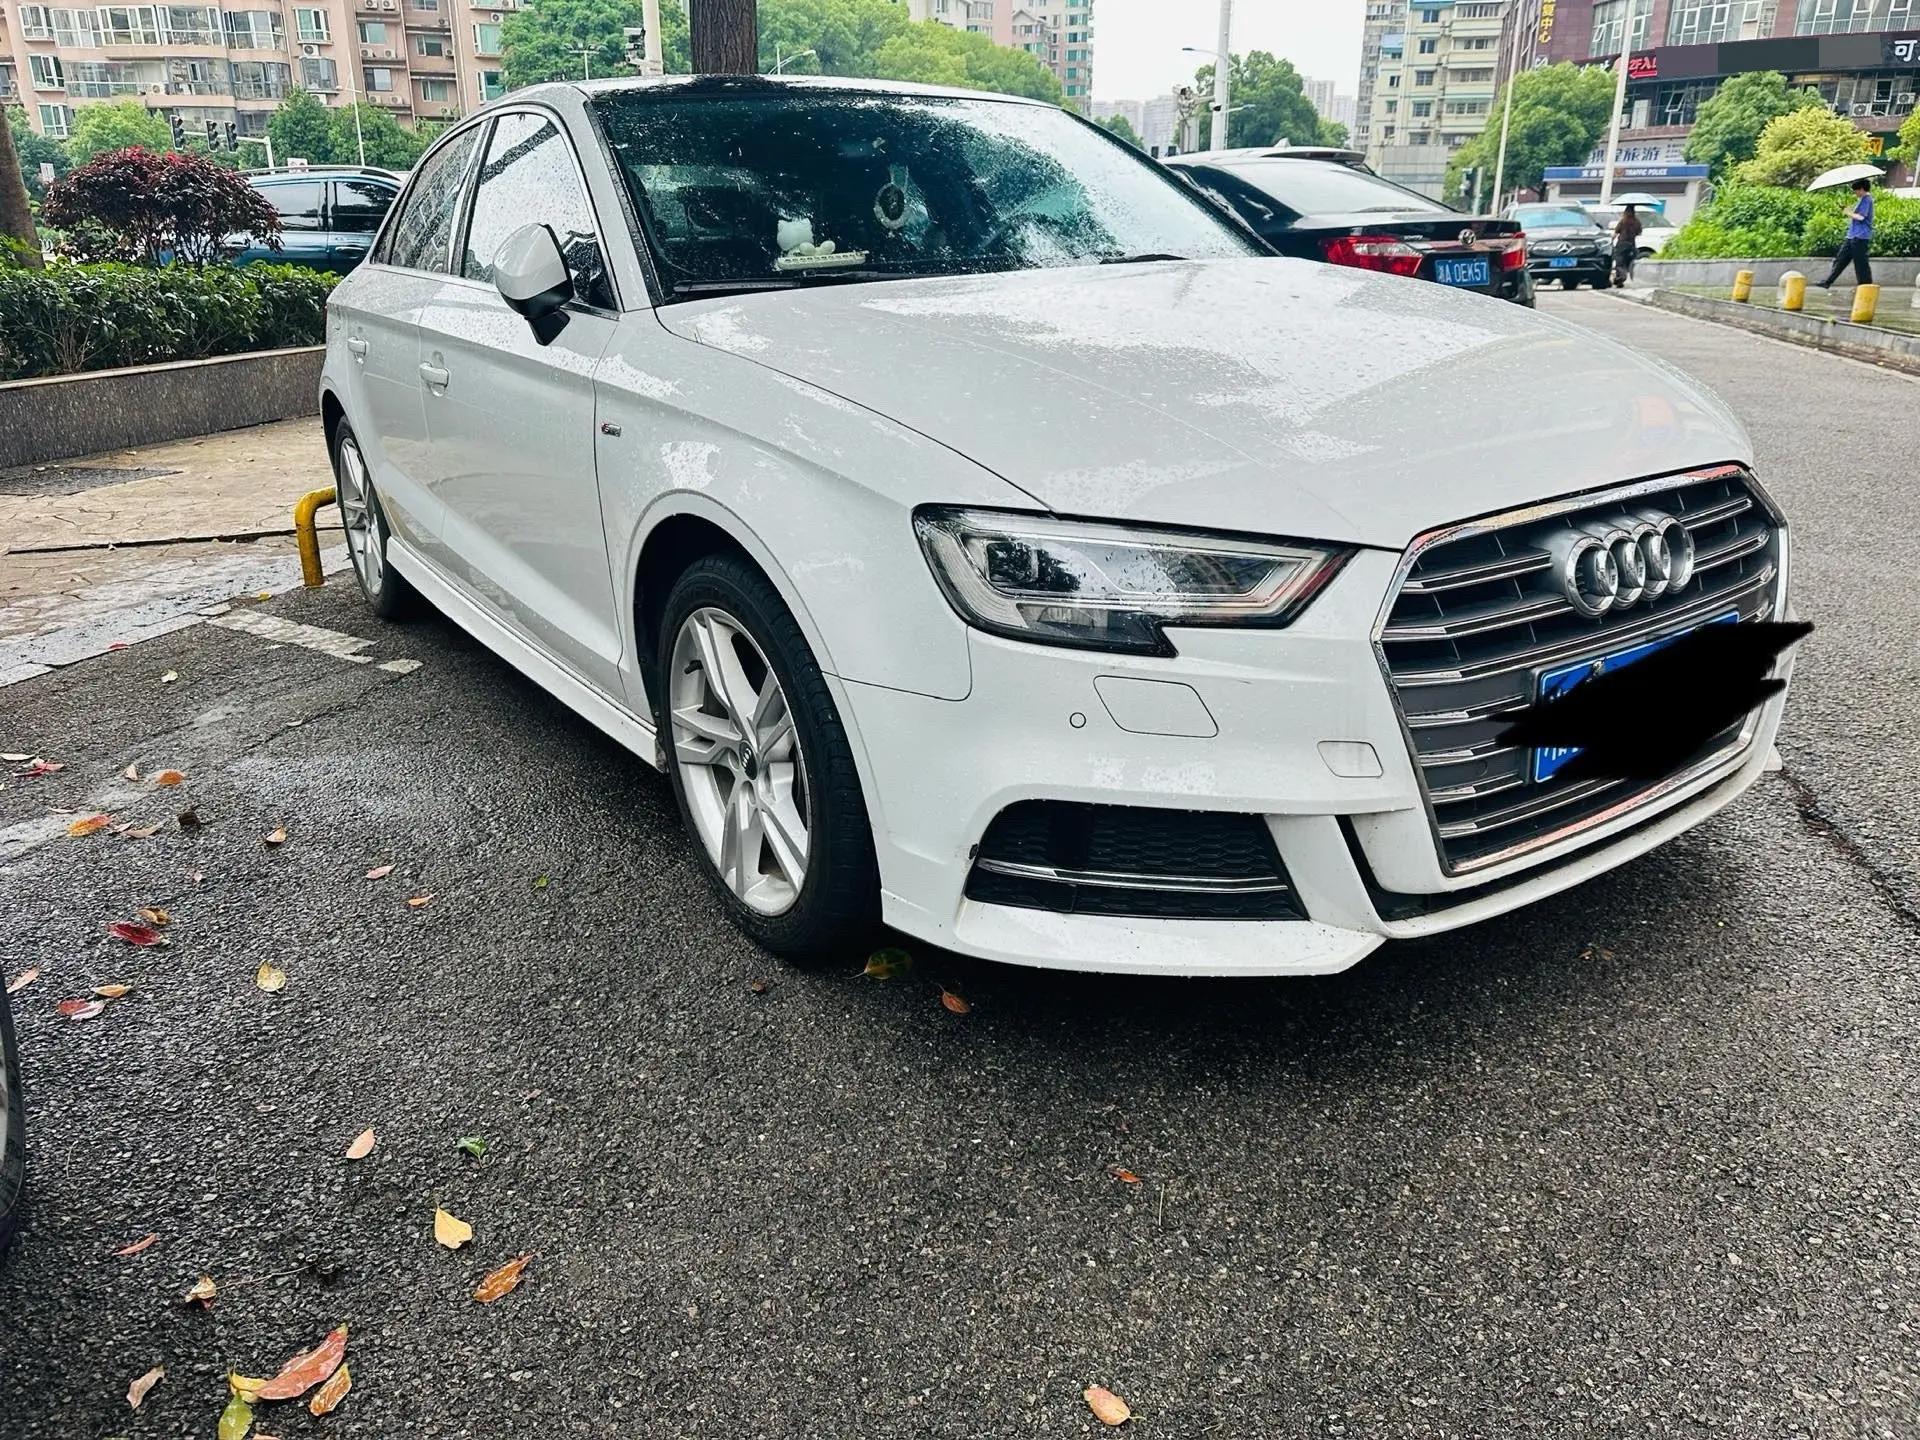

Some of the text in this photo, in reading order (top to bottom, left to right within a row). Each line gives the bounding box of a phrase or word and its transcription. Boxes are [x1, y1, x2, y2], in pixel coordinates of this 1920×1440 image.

[1538, 0, 1556, 43] 复中心
[1894, 40, 1920, 62] 可
[1625, 168, 1668, 176] TRAFFIC POLICE
